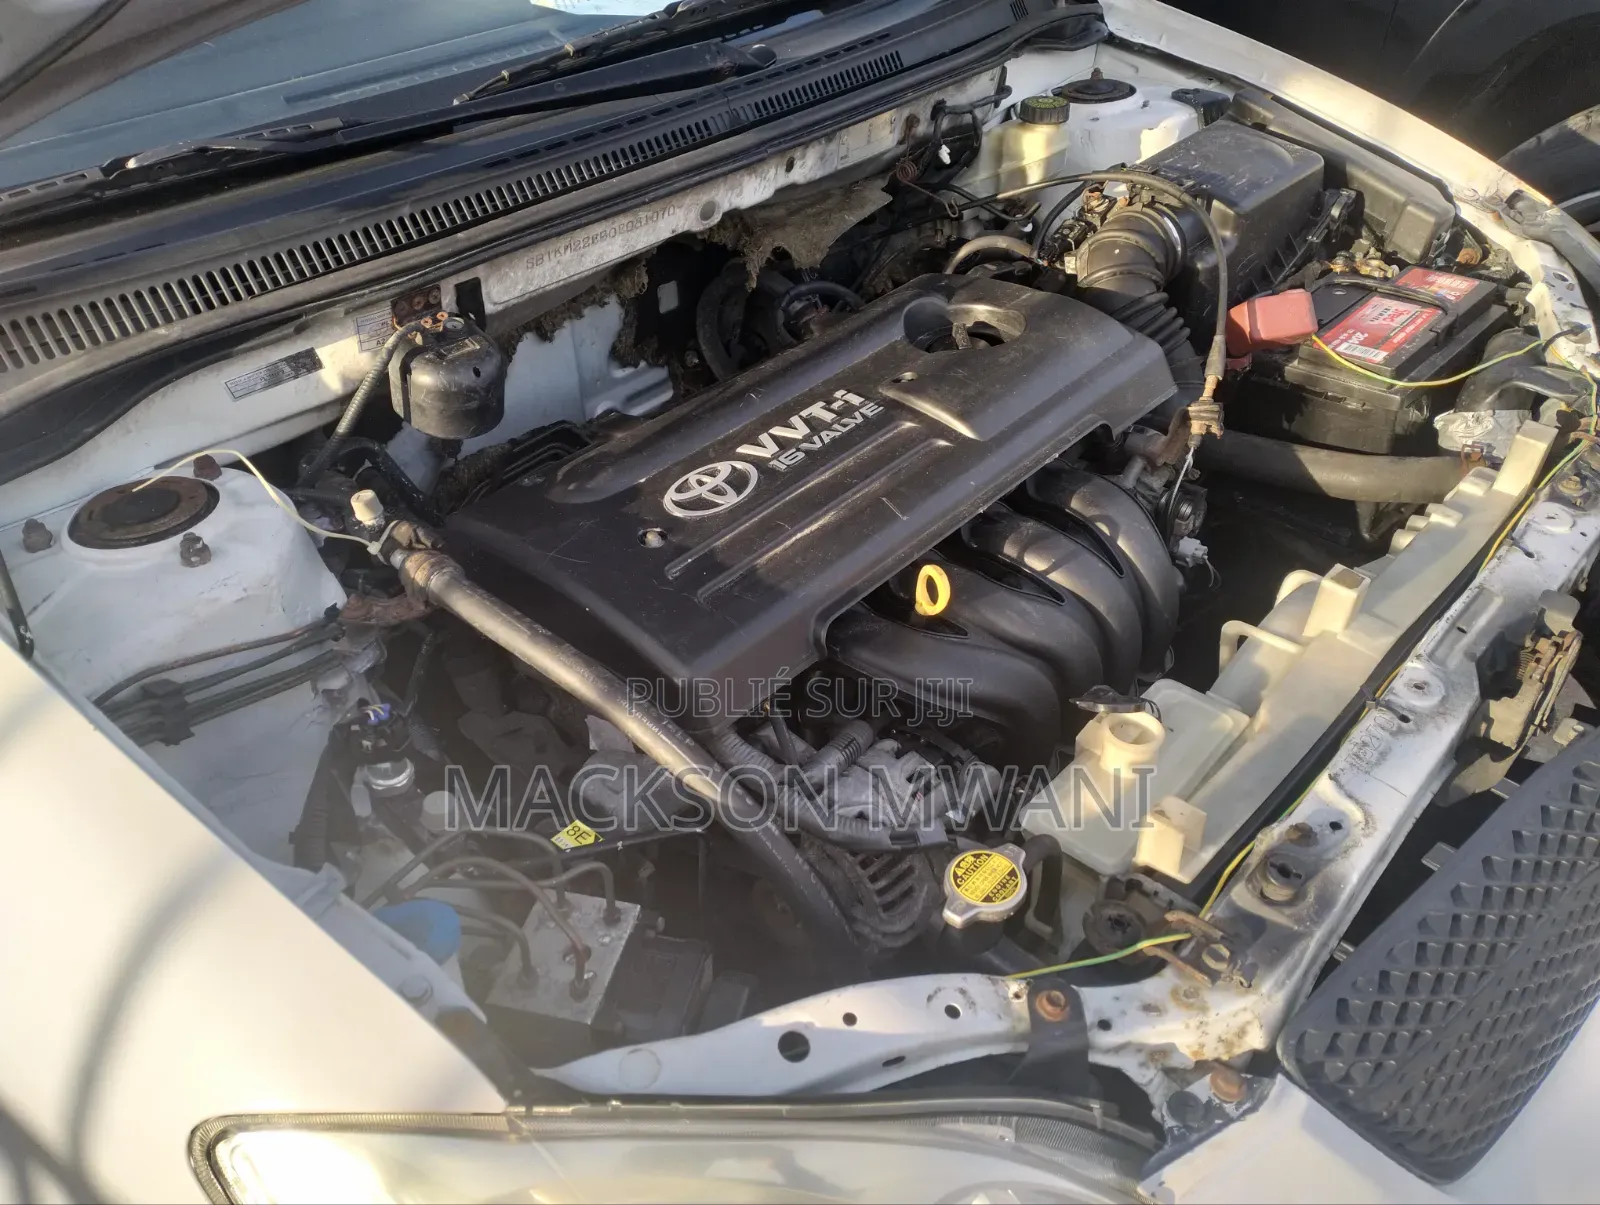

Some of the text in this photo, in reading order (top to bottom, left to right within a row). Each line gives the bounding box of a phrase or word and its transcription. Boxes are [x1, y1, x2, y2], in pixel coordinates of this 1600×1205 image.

[736, 389, 866, 458] VVT-i
[768, 403, 884, 472] 16 VALVE
[567, 825, 592, 845] 8E
[957, 853, 989, 885] CAUTION
[988, 875, 1011, 897] ENGINE
[992, 876, 1016, 901] COOLANT
